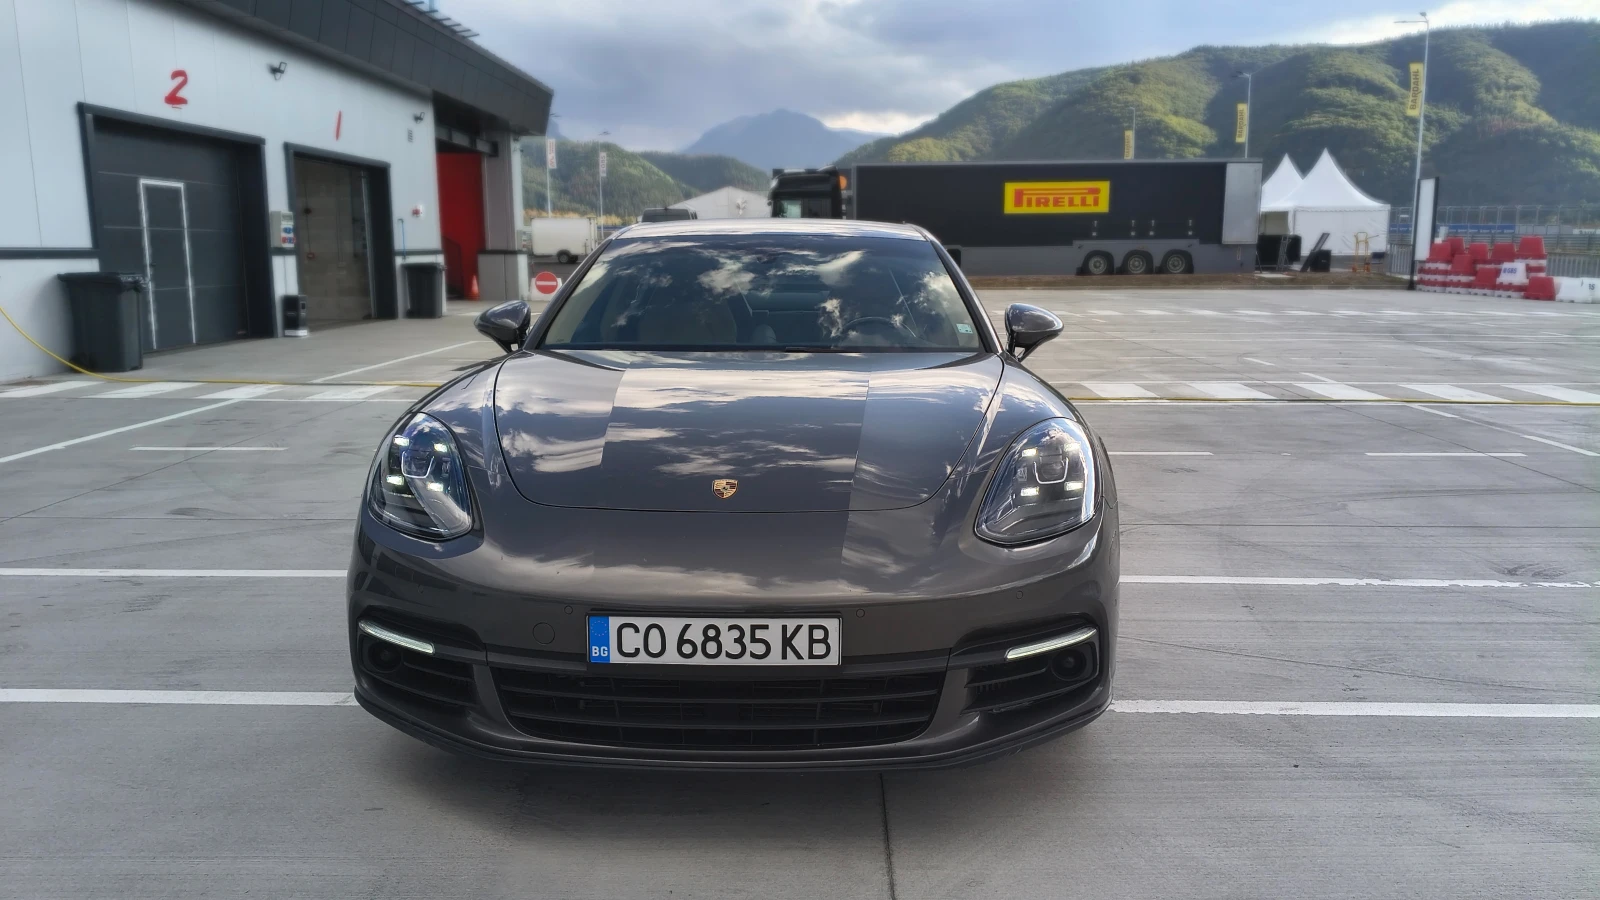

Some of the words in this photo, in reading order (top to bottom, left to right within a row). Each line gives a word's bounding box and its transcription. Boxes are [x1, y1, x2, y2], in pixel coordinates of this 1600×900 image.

[164, 69, 188, 105] 2
[1410, 68, 1422, 110] BARDAHL
[335, 110, 342, 141] 1
[1013, 187, 1101, 208] PIRELLI
[592, 646, 608, 657] BG
[617, 622, 667, 658] CO
[676, 623, 772, 660] 6835
[781, 624, 832, 660] KB
